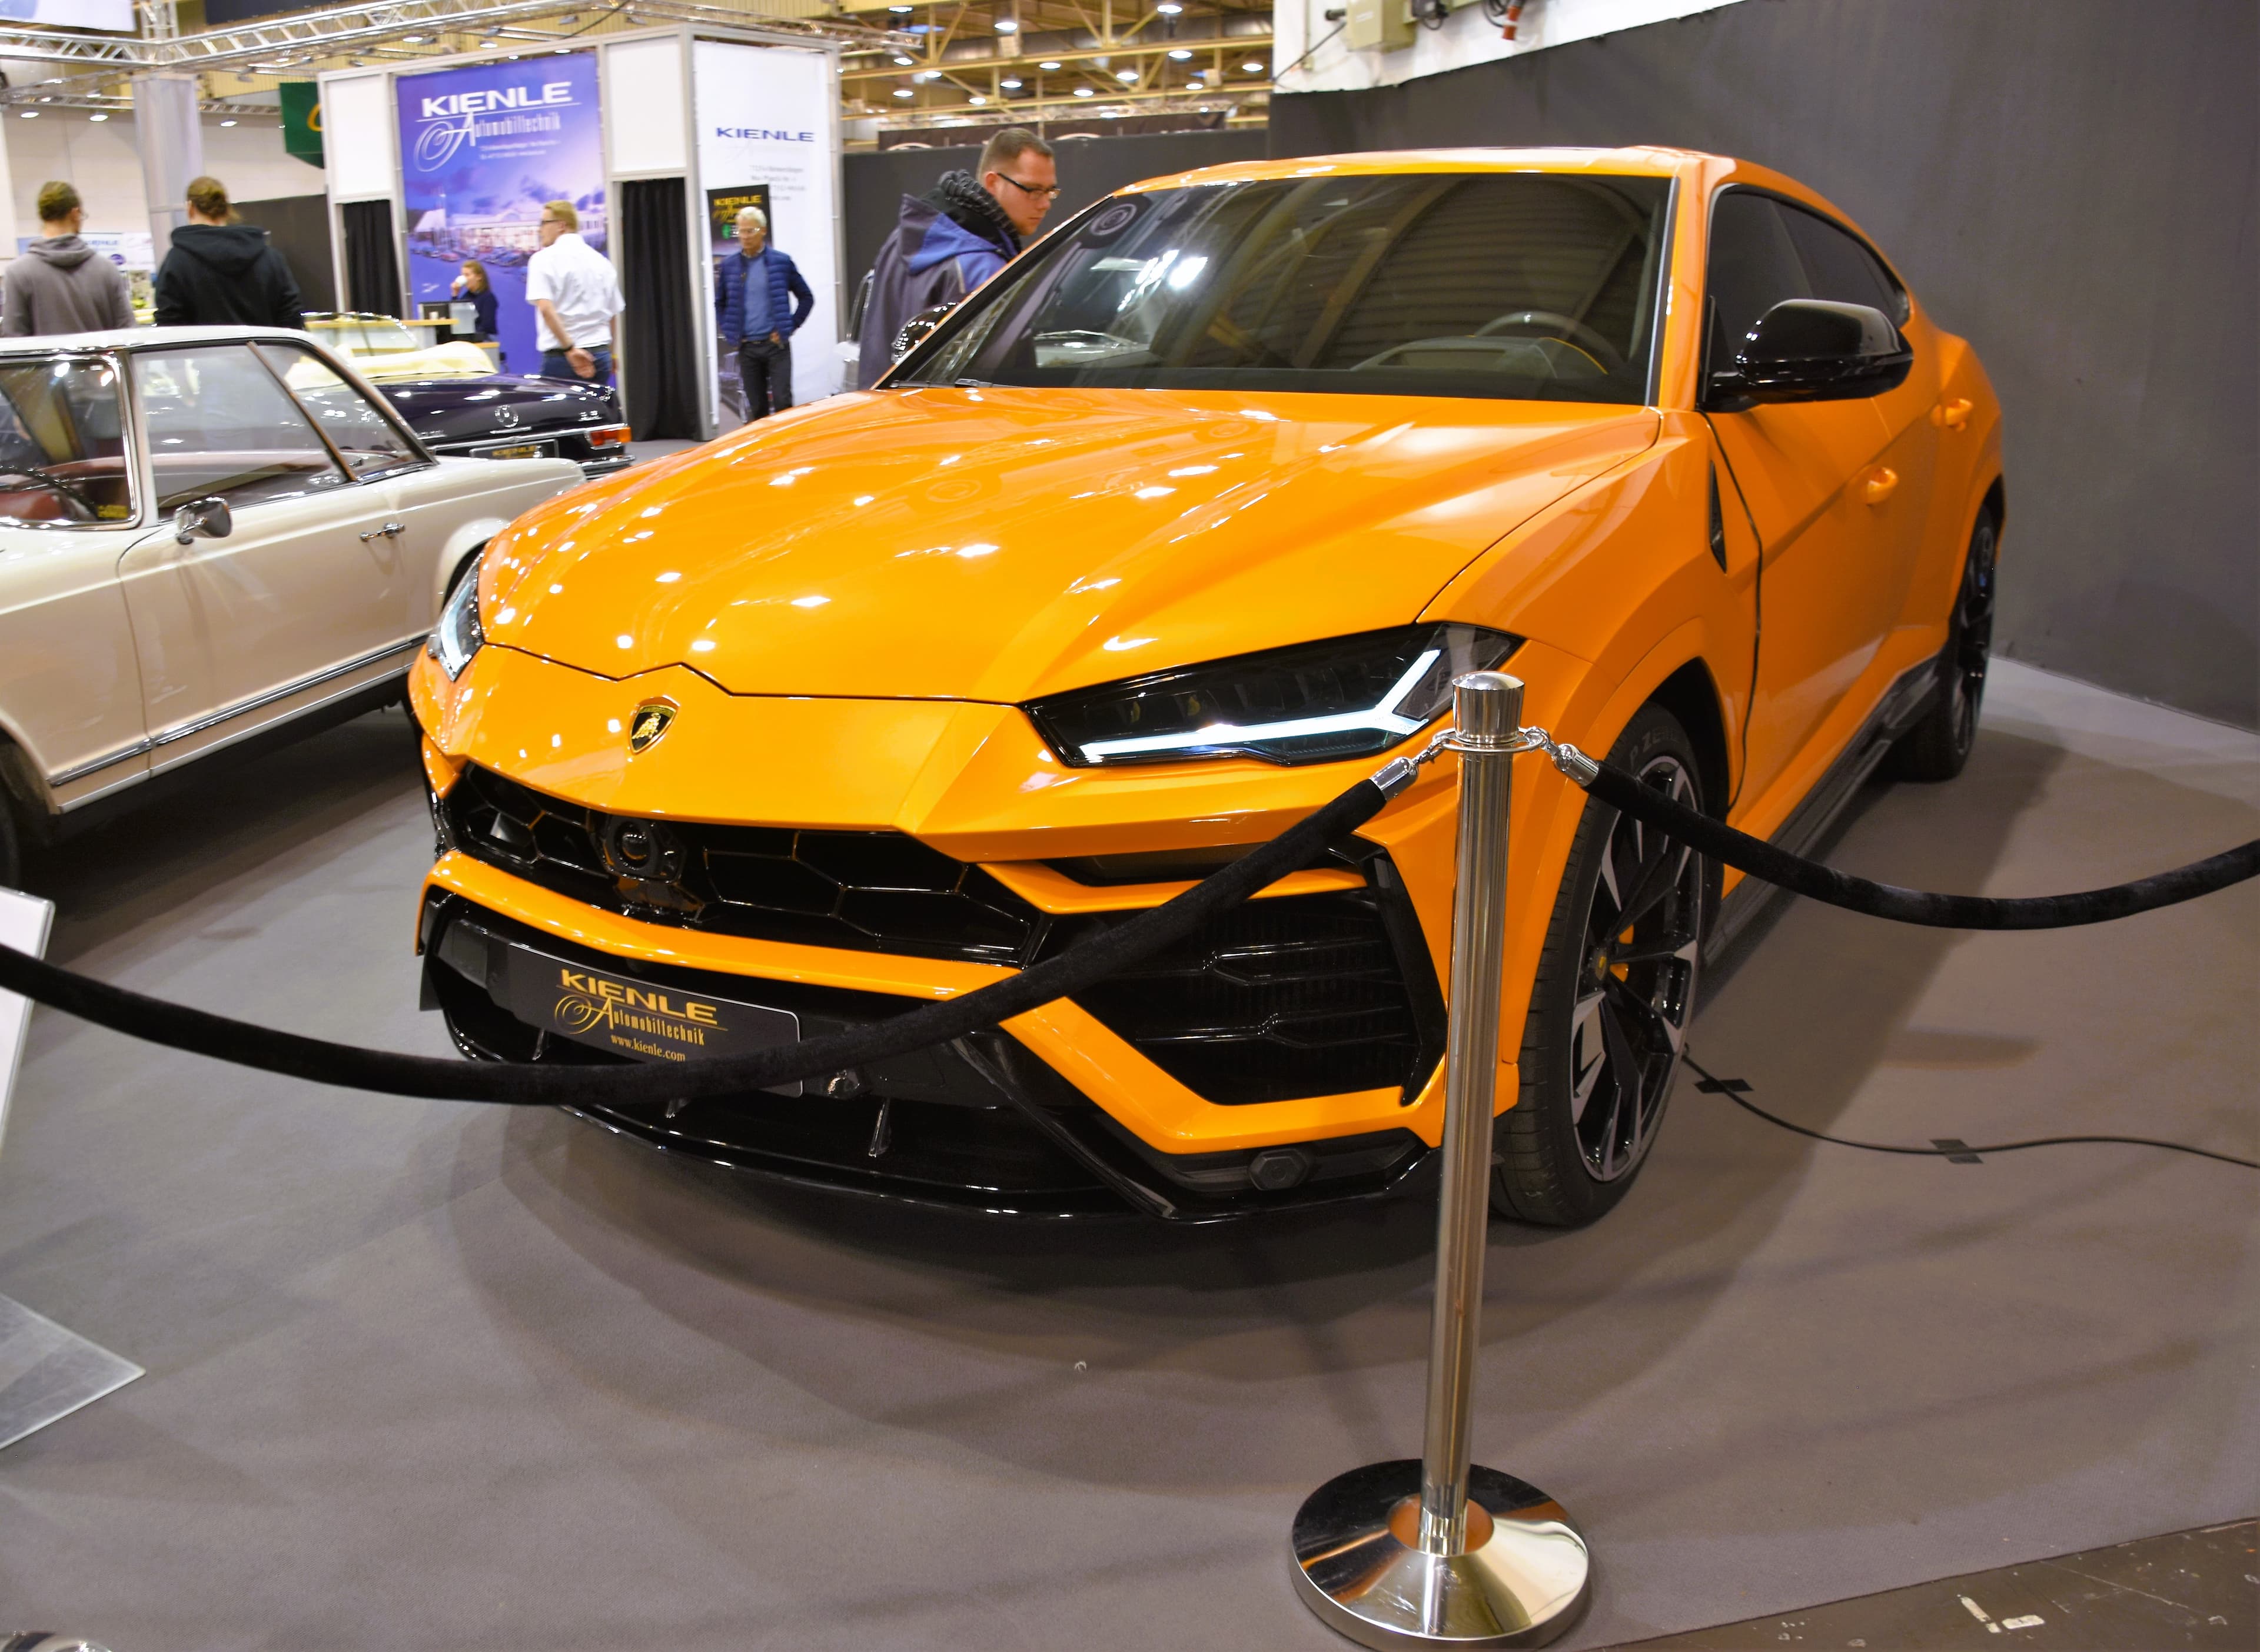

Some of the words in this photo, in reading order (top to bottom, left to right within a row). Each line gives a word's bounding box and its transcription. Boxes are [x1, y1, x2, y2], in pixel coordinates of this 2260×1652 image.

[422, 81, 573, 118] KIENLE
[716, 127, 815, 142] KIENLE
[561, 969, 718, 1025] KIENLE
[554, 993, 704, 1046] Automobiltechnik
[610, 1033, 686, 1062] www.kienle.com
